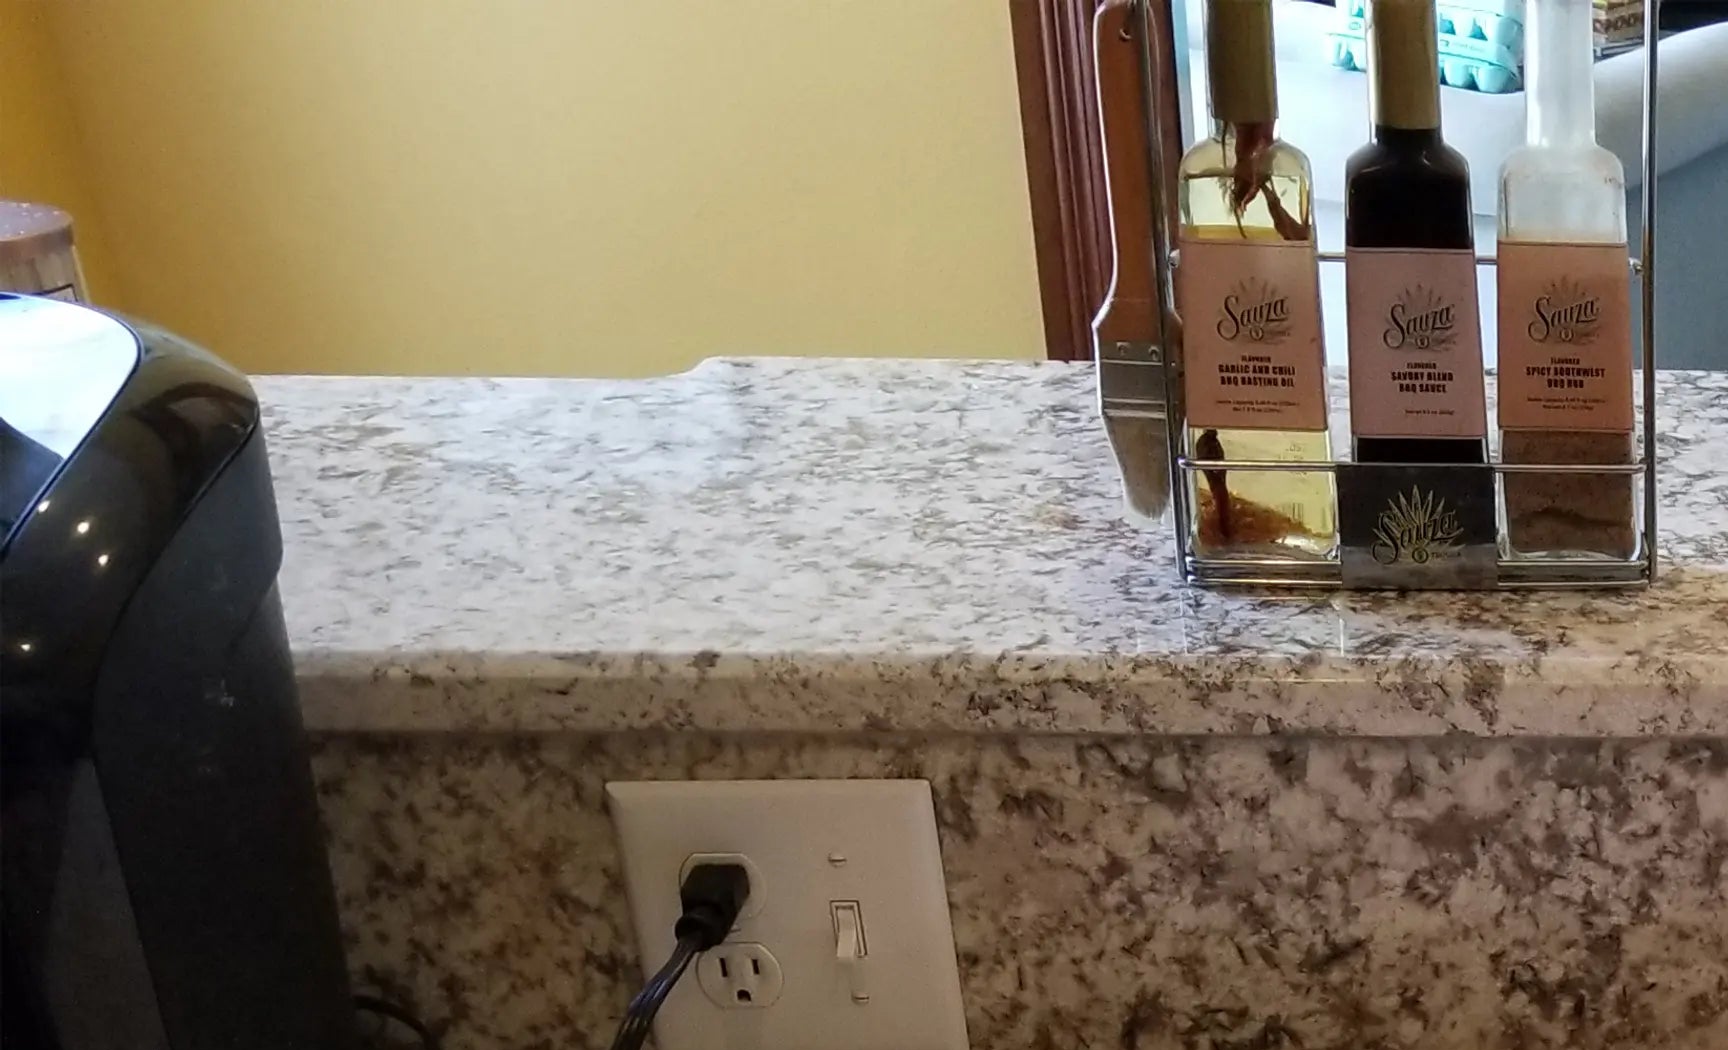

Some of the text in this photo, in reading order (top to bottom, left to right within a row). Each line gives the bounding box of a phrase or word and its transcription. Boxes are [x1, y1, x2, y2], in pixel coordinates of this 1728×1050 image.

[1217, 295, 1290, 340] Sauza
[1528, 296, 1599, 342] Sauza
[1383, 303, 1455, 349] Sauza
[1218, 364, 1296, 376] GARLIC AND CHILI
[1391, 371, 1454, 381] SAVORY BLEND
[1526, 366, 1606, 378] SPICY SOUTHWEST
[1281, 377, 1295, 387] OIL
[1419, 383, 1447, 393] SAUCE
